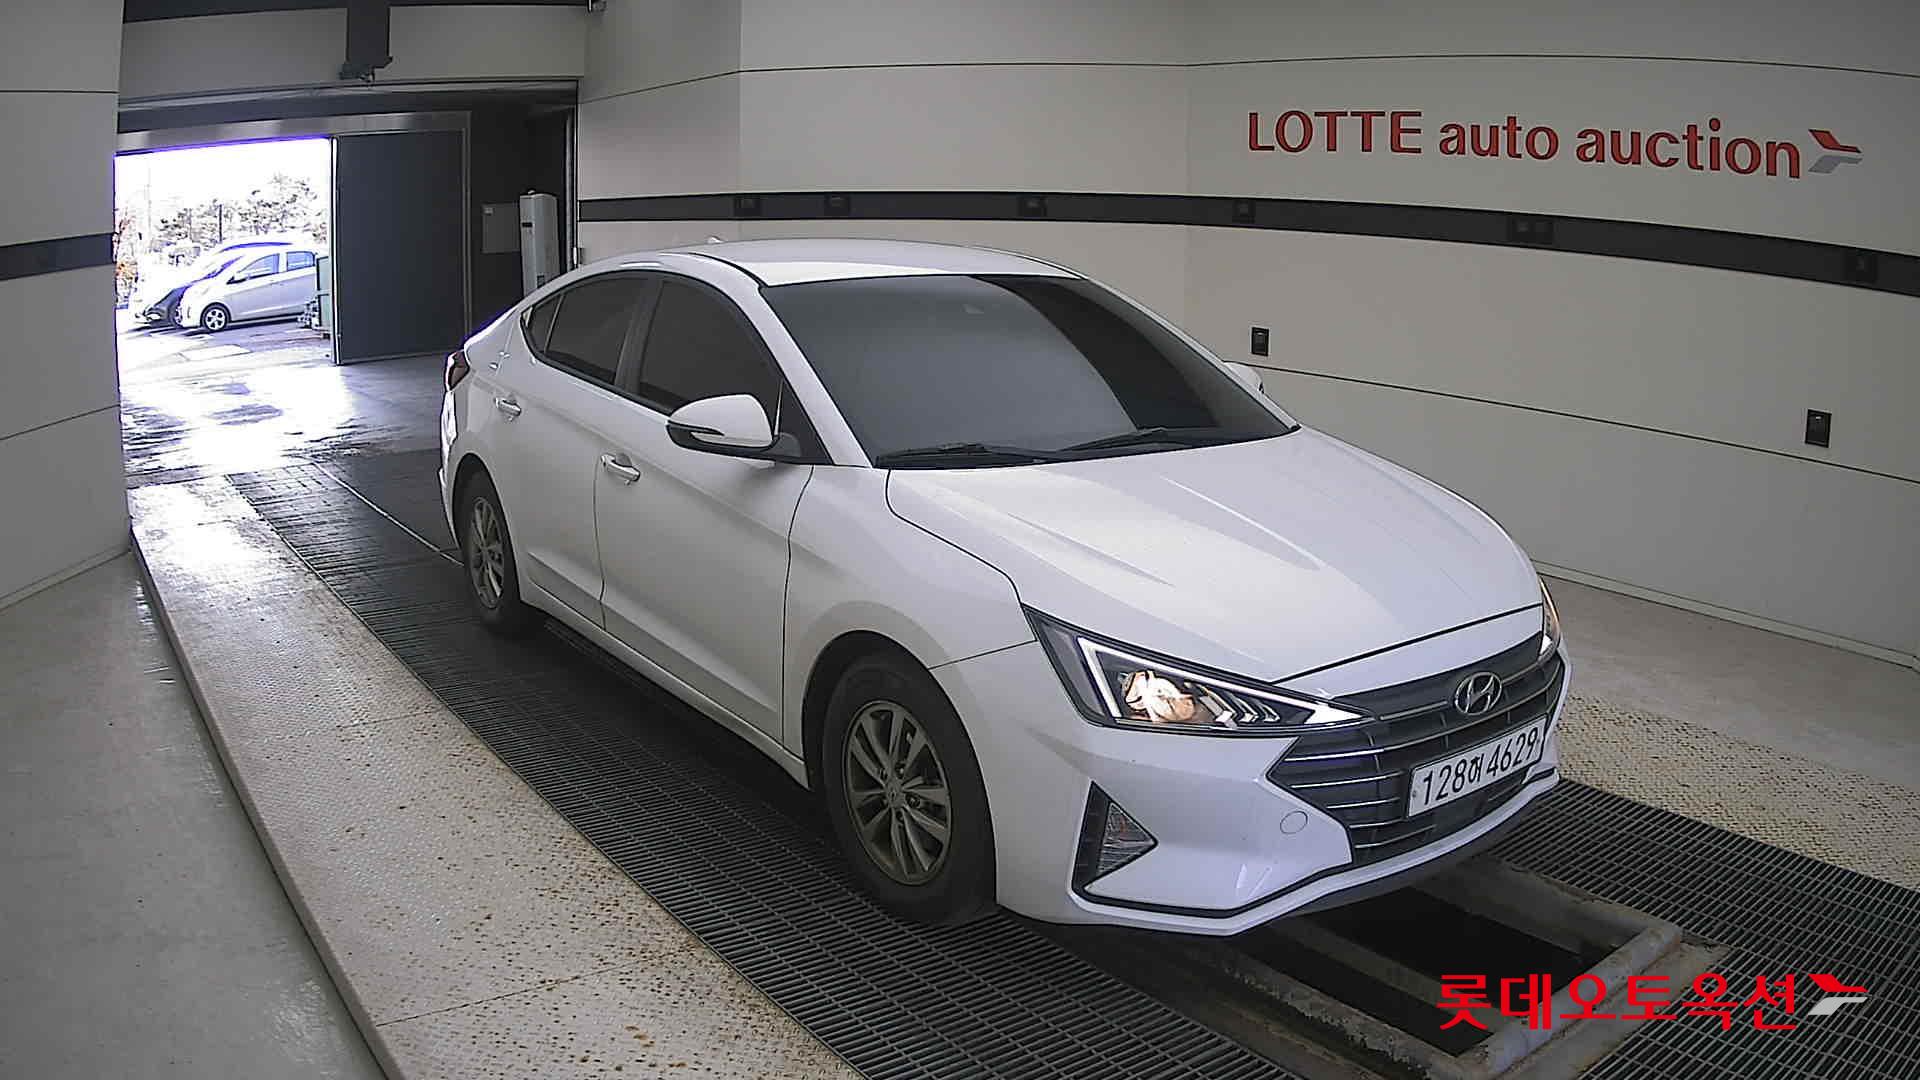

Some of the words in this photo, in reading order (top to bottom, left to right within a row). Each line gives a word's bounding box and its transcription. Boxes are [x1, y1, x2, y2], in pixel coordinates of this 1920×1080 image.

[1248, 111, 1423, 155] LOTTE
[1439, 116, 1560, 160] auto
[1576, 118, 1801, 179] auction
